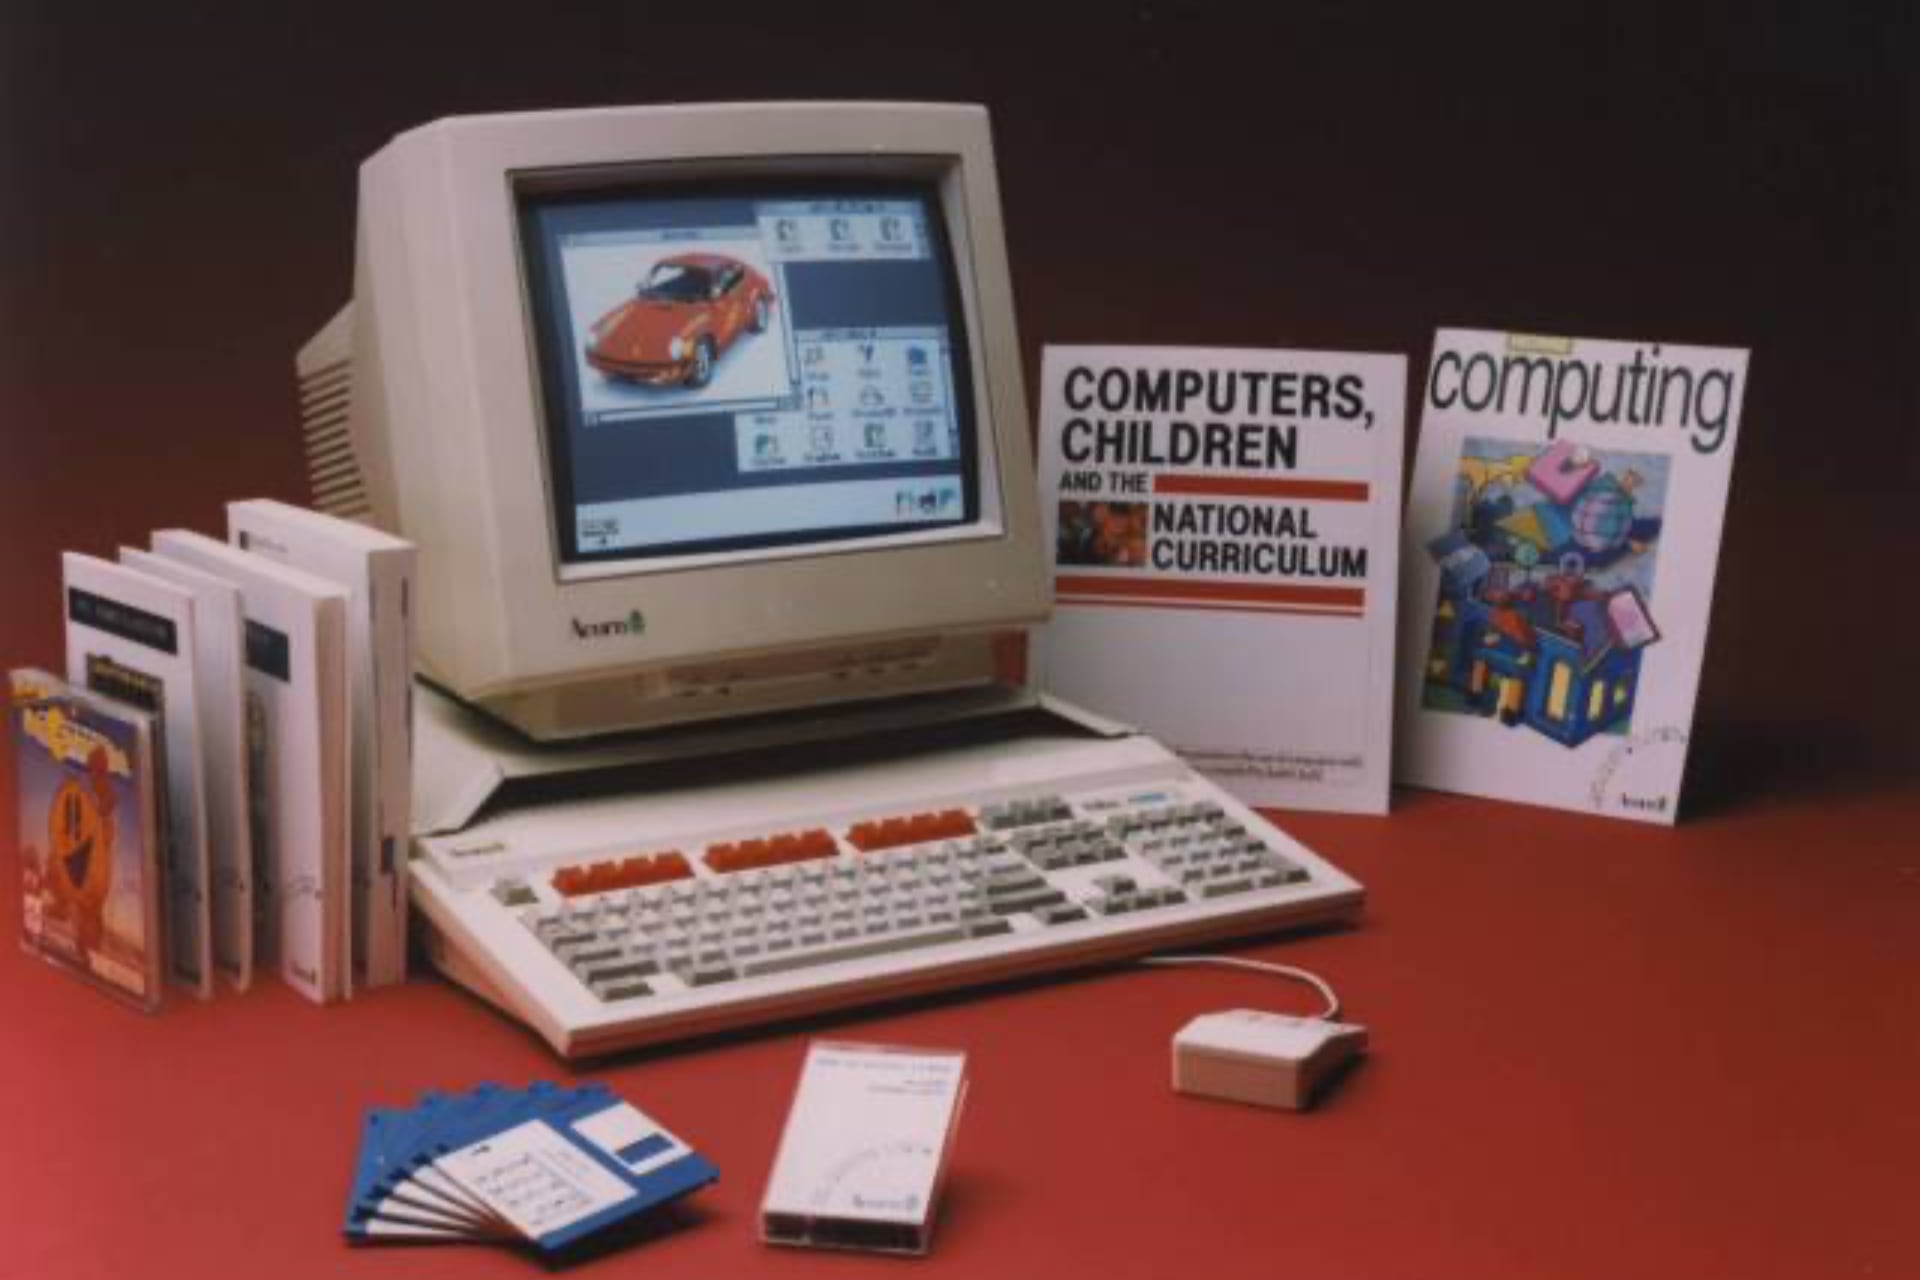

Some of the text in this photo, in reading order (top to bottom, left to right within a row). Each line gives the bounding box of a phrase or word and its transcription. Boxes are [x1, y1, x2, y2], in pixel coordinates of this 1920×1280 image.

[1063, 366, 1374, 430] COMPUTERS,
[1430, 346, 1734, 453] computing
[1060, 417, 1297, 468] CHILDREN
[1058, 471, 1148, 493] AND THE
[1153, 503, 1318, 539] NATIONAL
[1151, 538, 1367, 578] CURRICULUM
